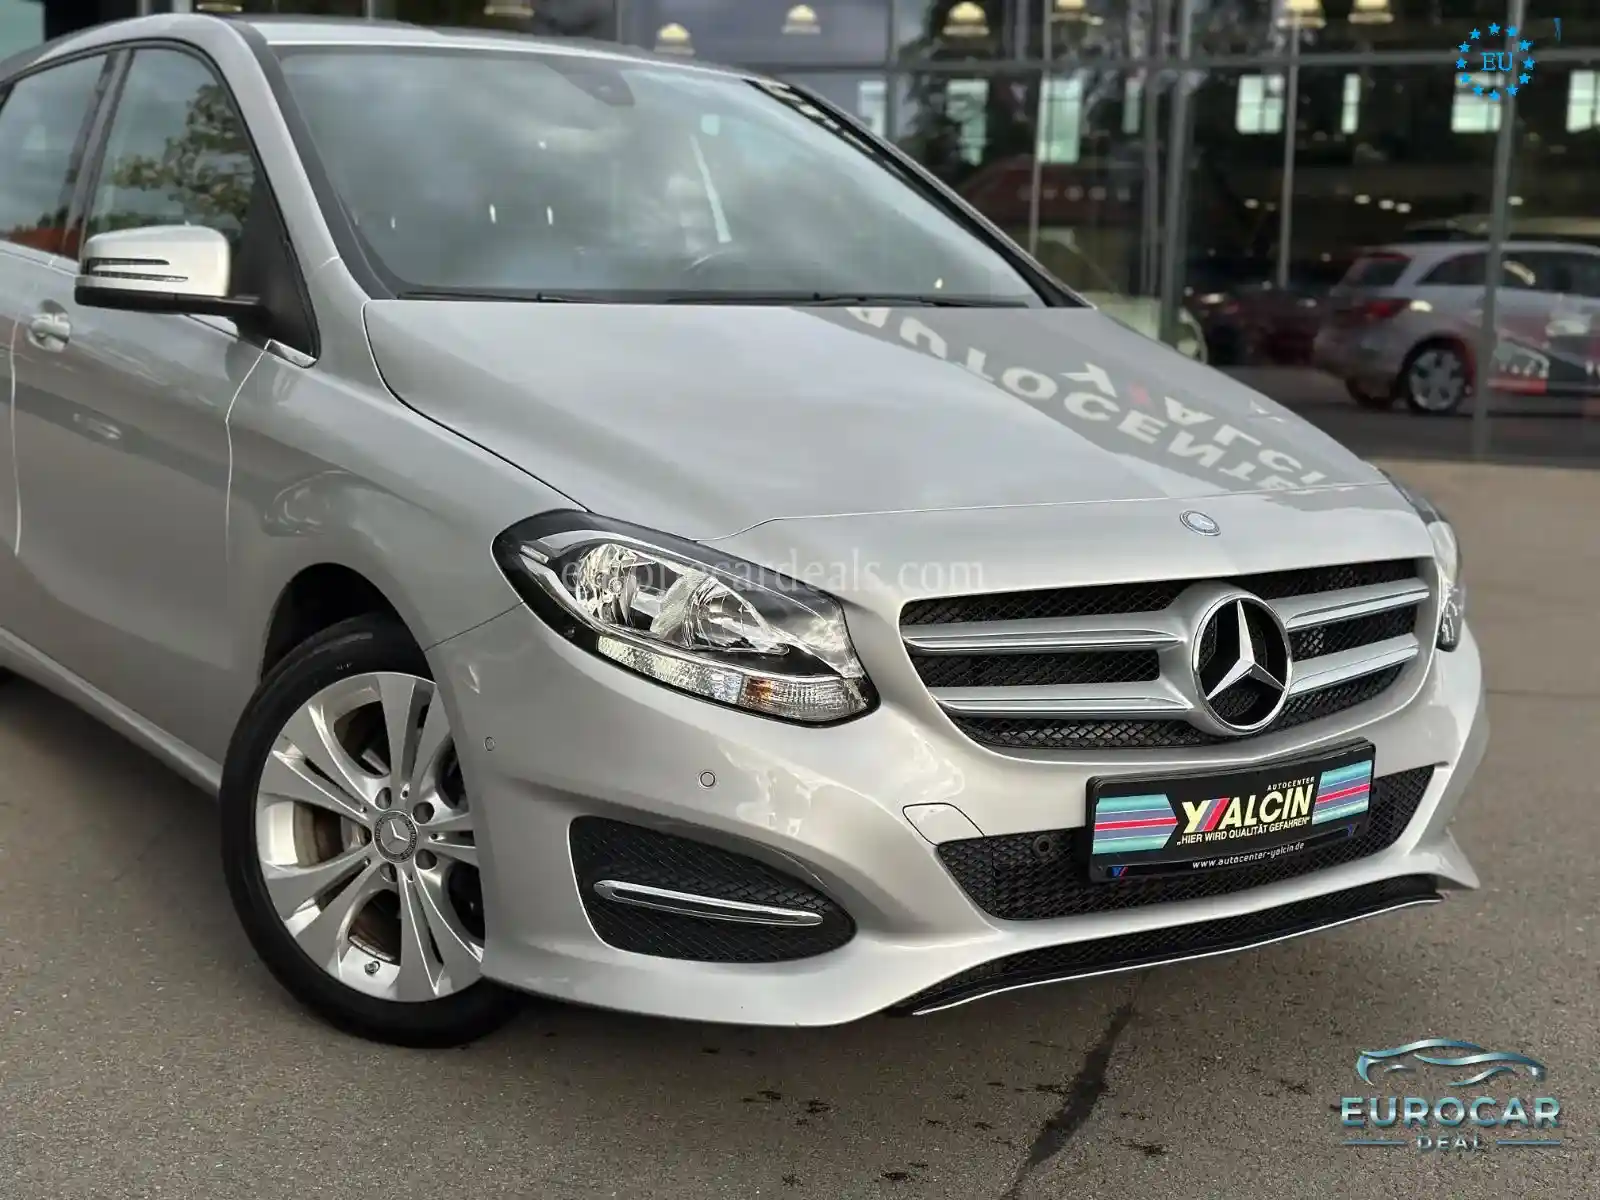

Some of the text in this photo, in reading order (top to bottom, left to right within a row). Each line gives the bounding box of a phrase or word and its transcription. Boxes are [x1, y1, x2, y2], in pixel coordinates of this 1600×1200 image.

[1267, 776, 1315, 791] AUTOCENTER
[1204, 830, 1228, 842] WIRD
[1228, 823, 1268, 839] QUALITÄT
[1192, 841, 1305, 869] www.autocenter-yalcin.de
